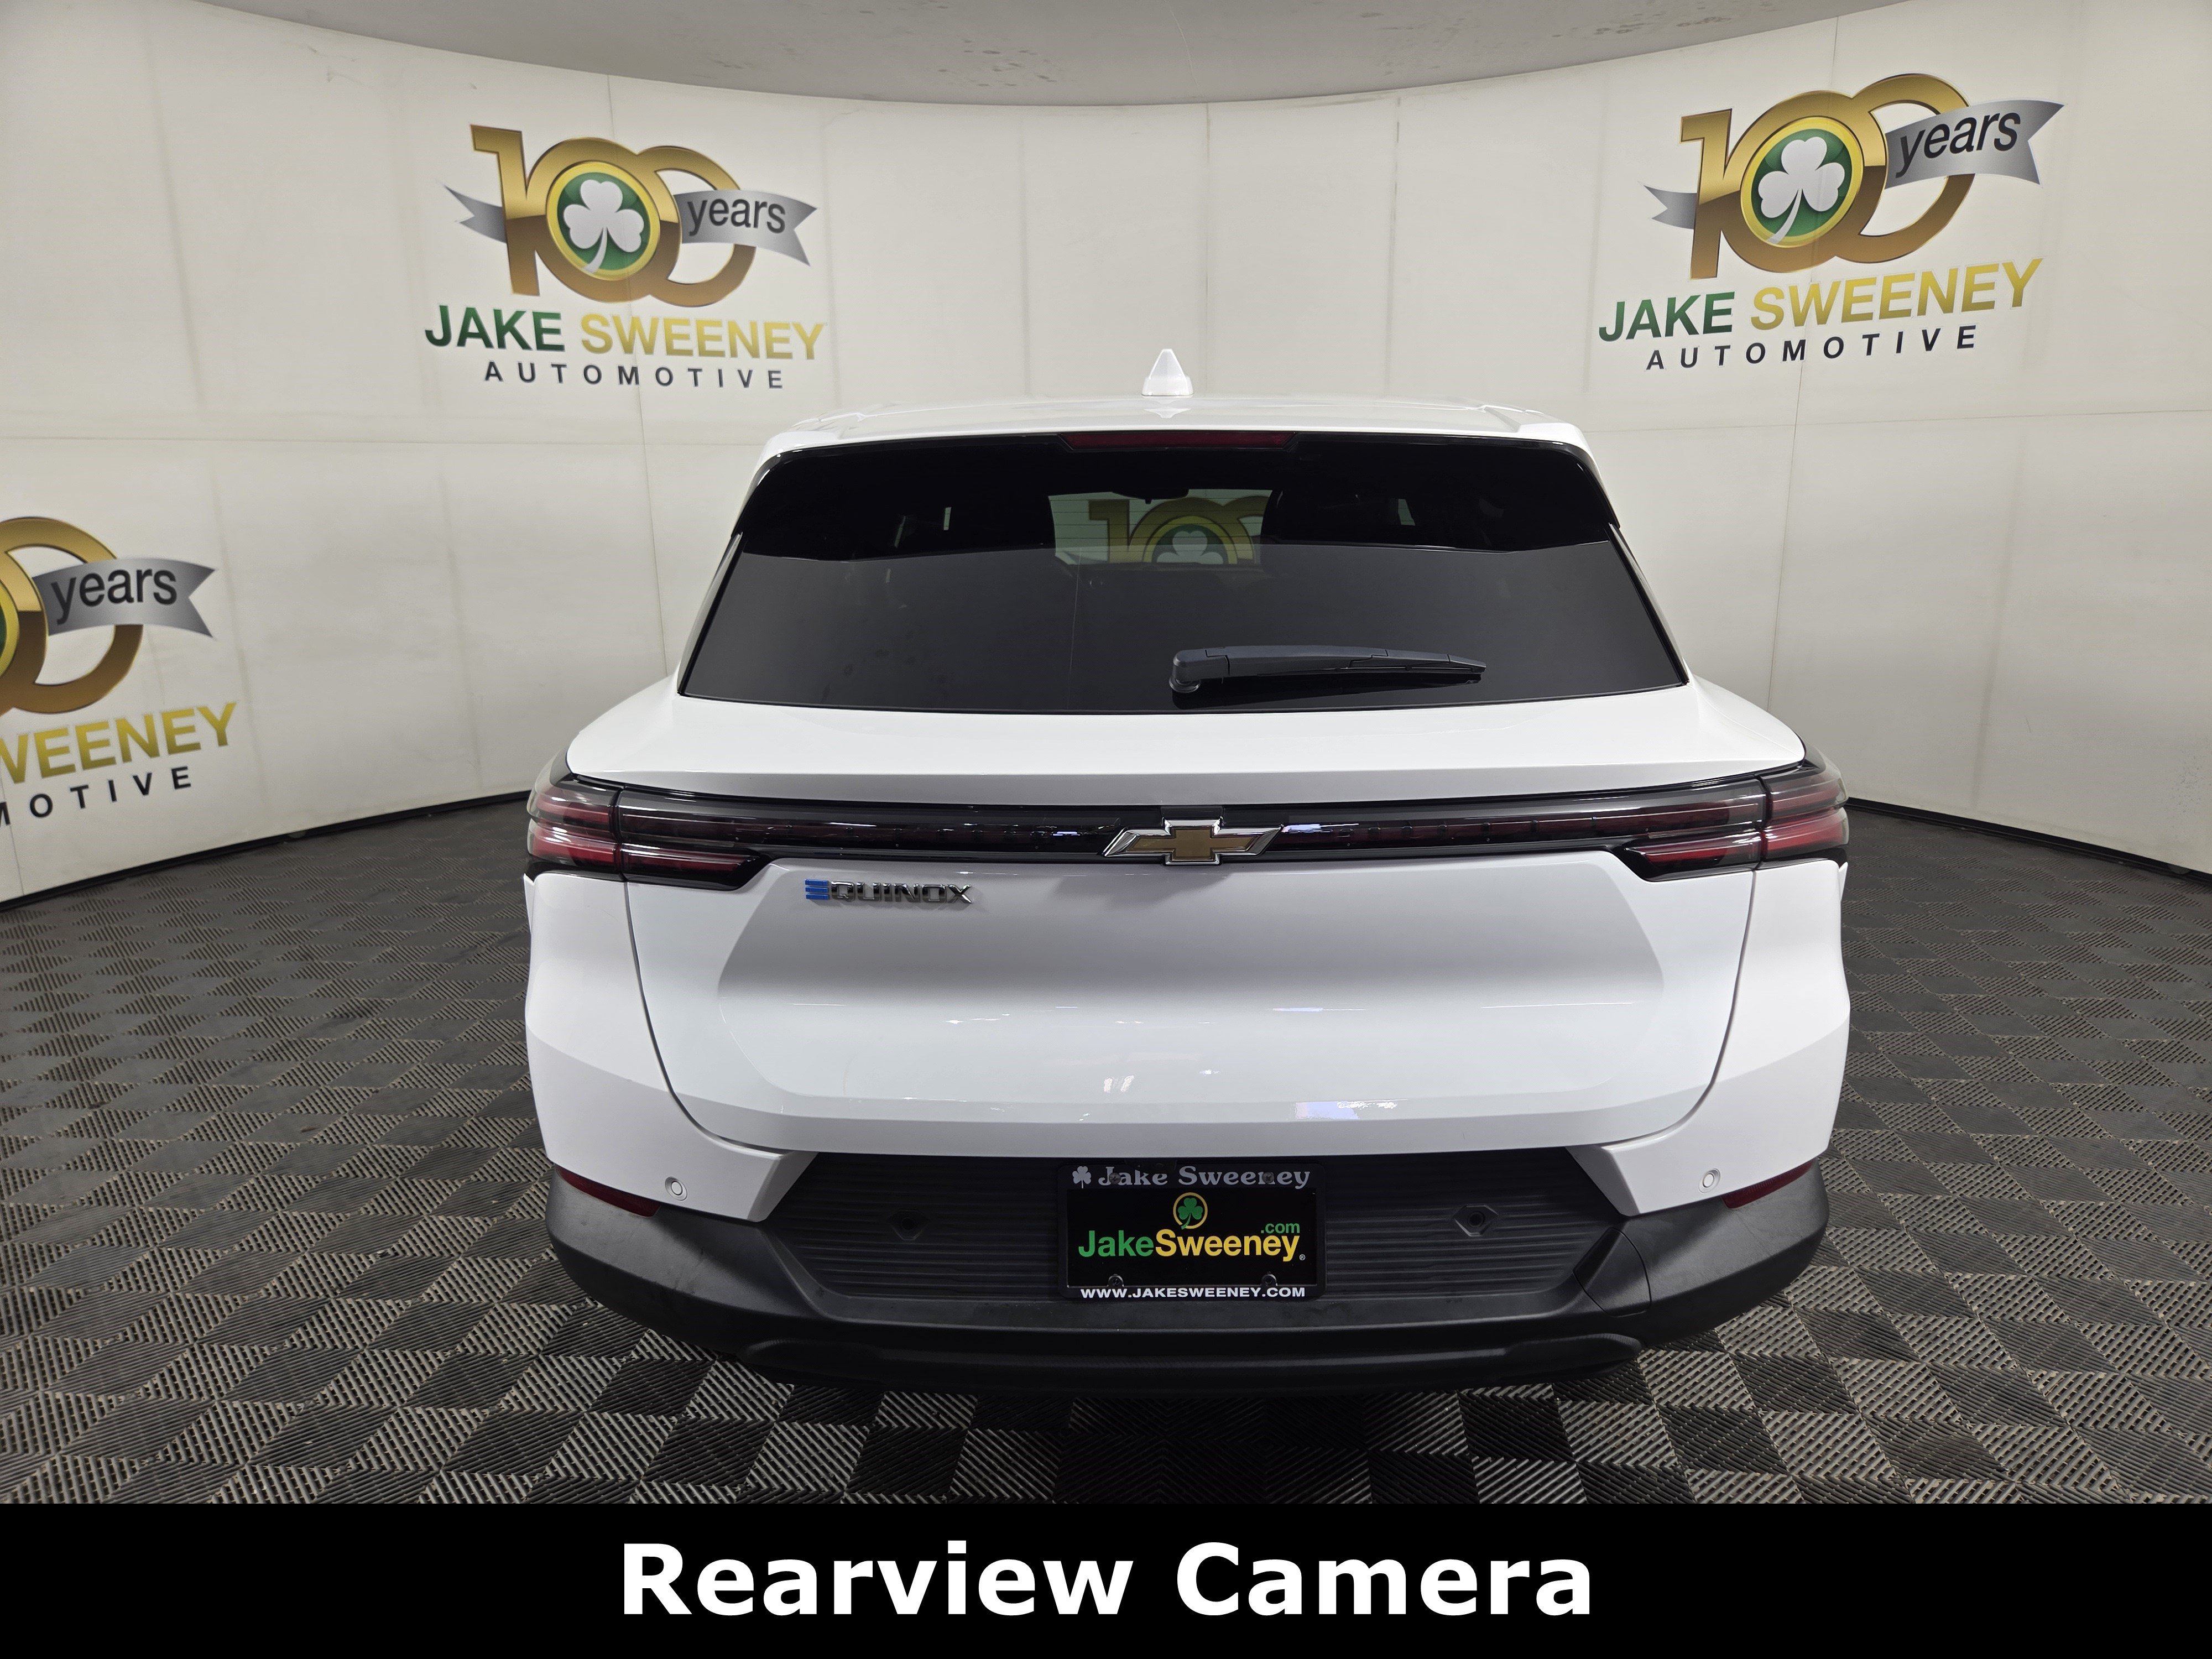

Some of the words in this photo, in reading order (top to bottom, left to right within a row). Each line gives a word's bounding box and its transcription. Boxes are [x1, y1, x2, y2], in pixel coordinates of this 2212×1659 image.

[1896, 110, 2021, 179] years
[1681, 72, 1979, 280] 100
[470, 124, 756, 307] 100
[687, 197, 787, 236] years
[1598, 291, 1735, 342] JAKE
[1750, 258, 2044, 332] SWEENEY
[425, 305, 566, 352] JAKE
[581, 312, 824, 361] SWEENEY
[1646, 325, 1977, 371] AUTOMOTIVE
[484, 361, 783, 389] AUTOMOTIVE
[51, 568, 178, 625] years
[805, 879, 972, 904] EQUINOX
[1098, 1166, 1168, 1186] Jake
[1178, 1166, 1310, 1190] Sweeney
[1080, 1287, 1305, 1298] WWW.JAKESWEENEY.COM
